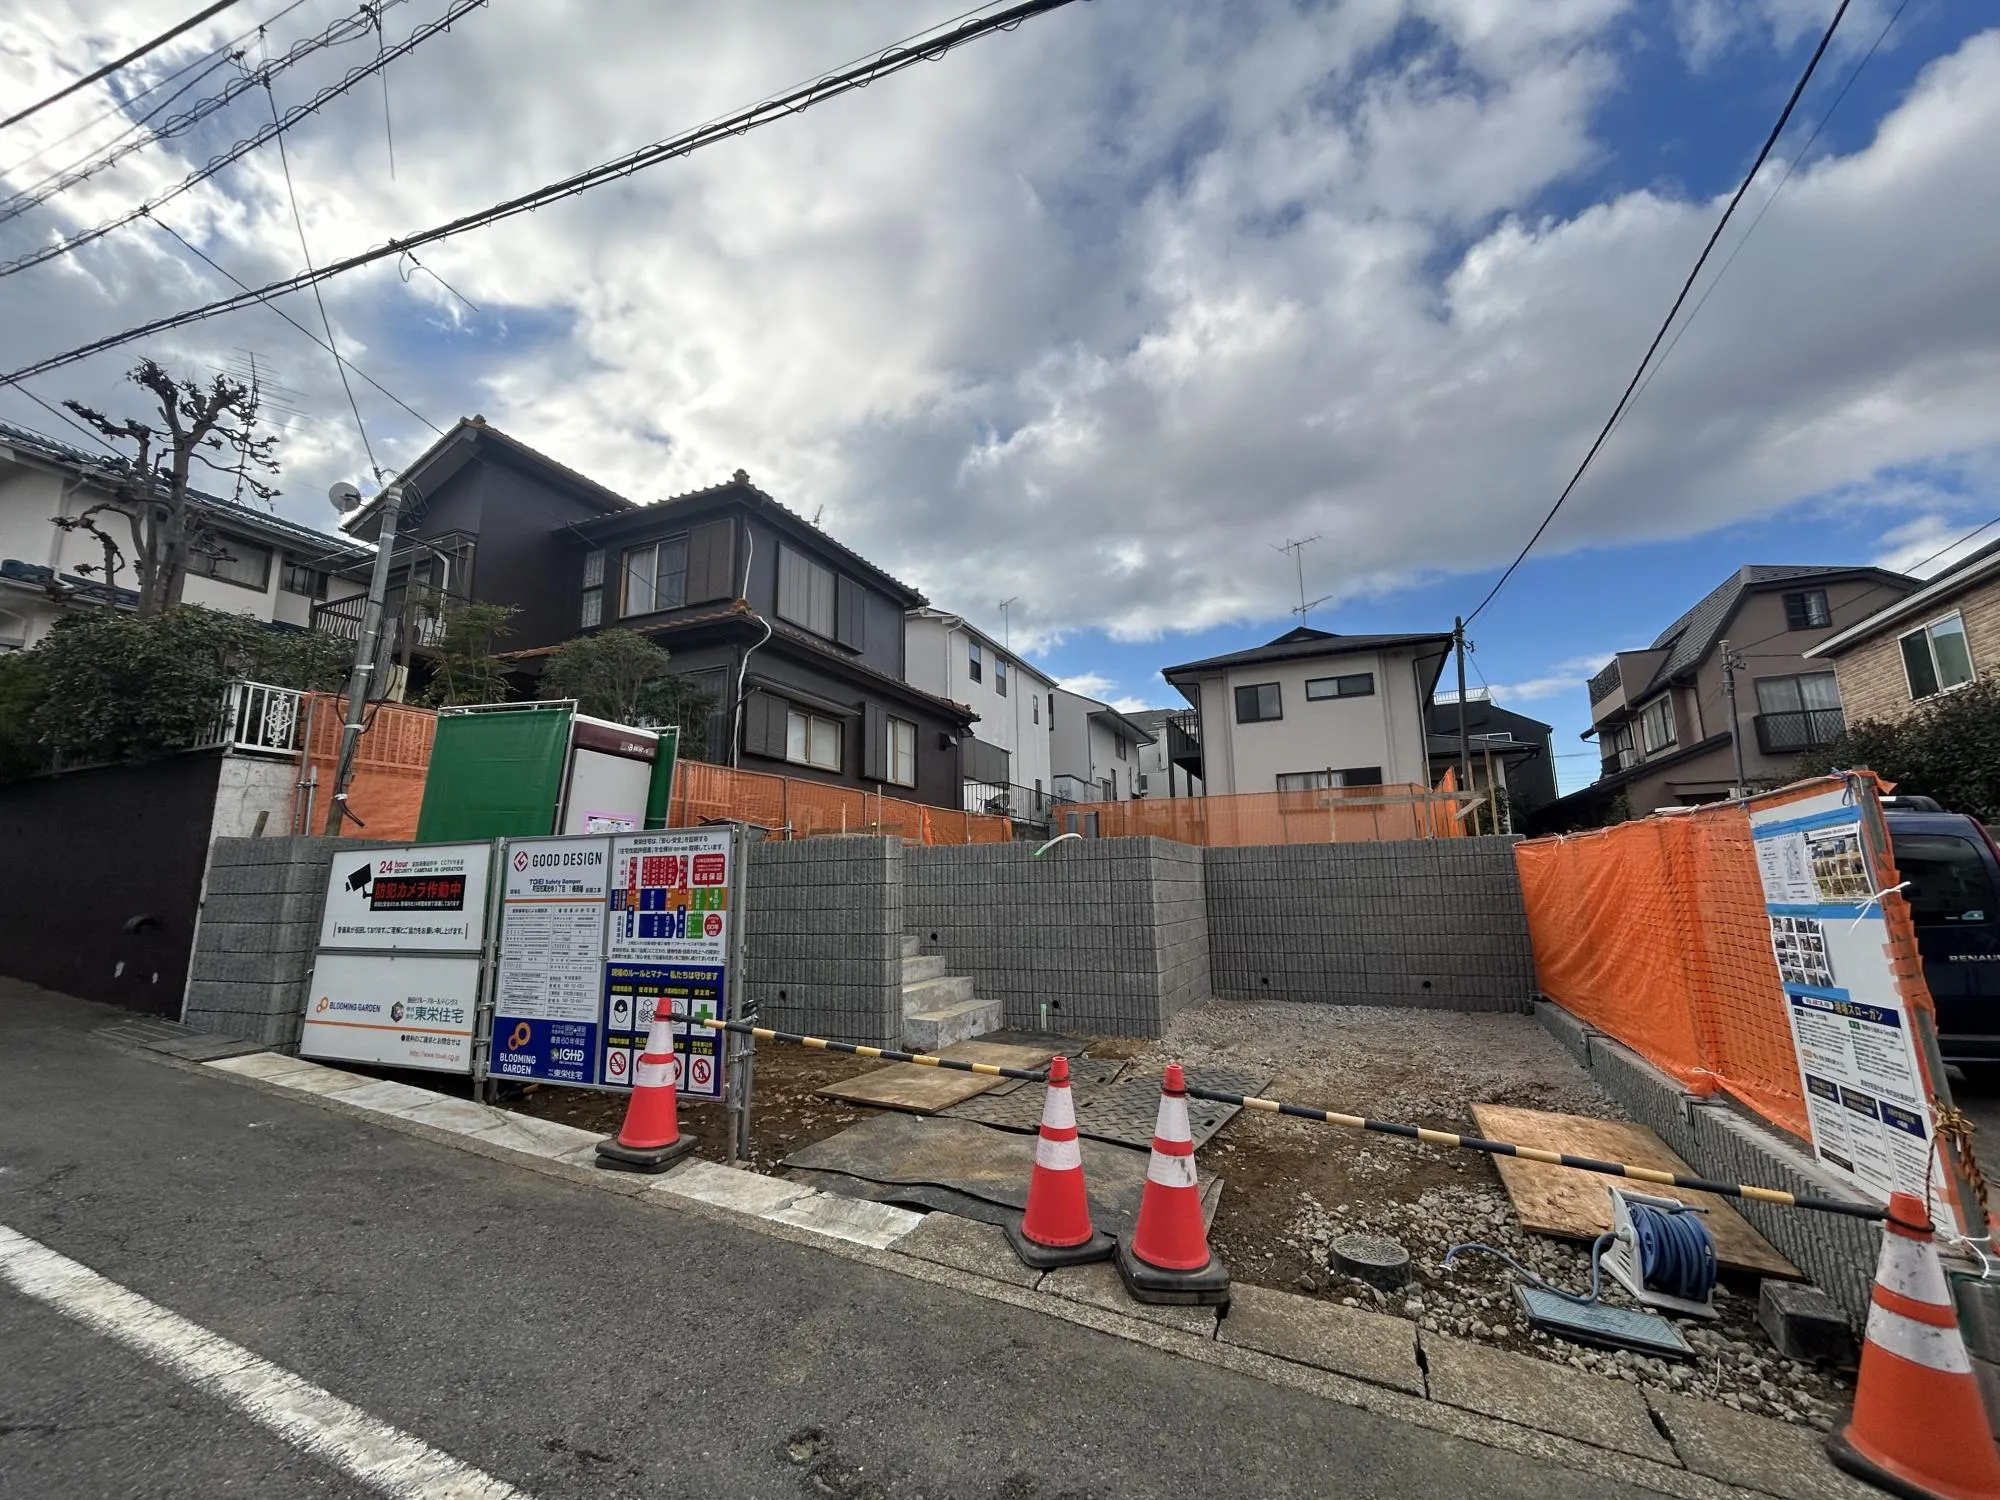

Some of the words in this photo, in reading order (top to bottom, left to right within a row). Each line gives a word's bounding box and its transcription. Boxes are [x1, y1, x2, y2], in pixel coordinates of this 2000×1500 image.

[532, 853, 560, 867] GOOD
[563, 852, 602, 866] DESIGN
[379, 860, 393, 874] 24
[374, 881, 461, 899] 防犯カメラ作動中
[611, 968, 669, 977] 現場のルールとマナー
[670, 971, 718, 980] 私たちは守ります
[329, 1001, 357, 1011] BLOOMING
[358, 1003, 381, 1013] GARDEN
[414, 1006, 464, 1024] 東栄住宅
[500, 1052, 536, 1065] BLOOMING
[559, 1048, 584, 1062] IGHD
[502, 1063, 532, 1075] GARDEN
